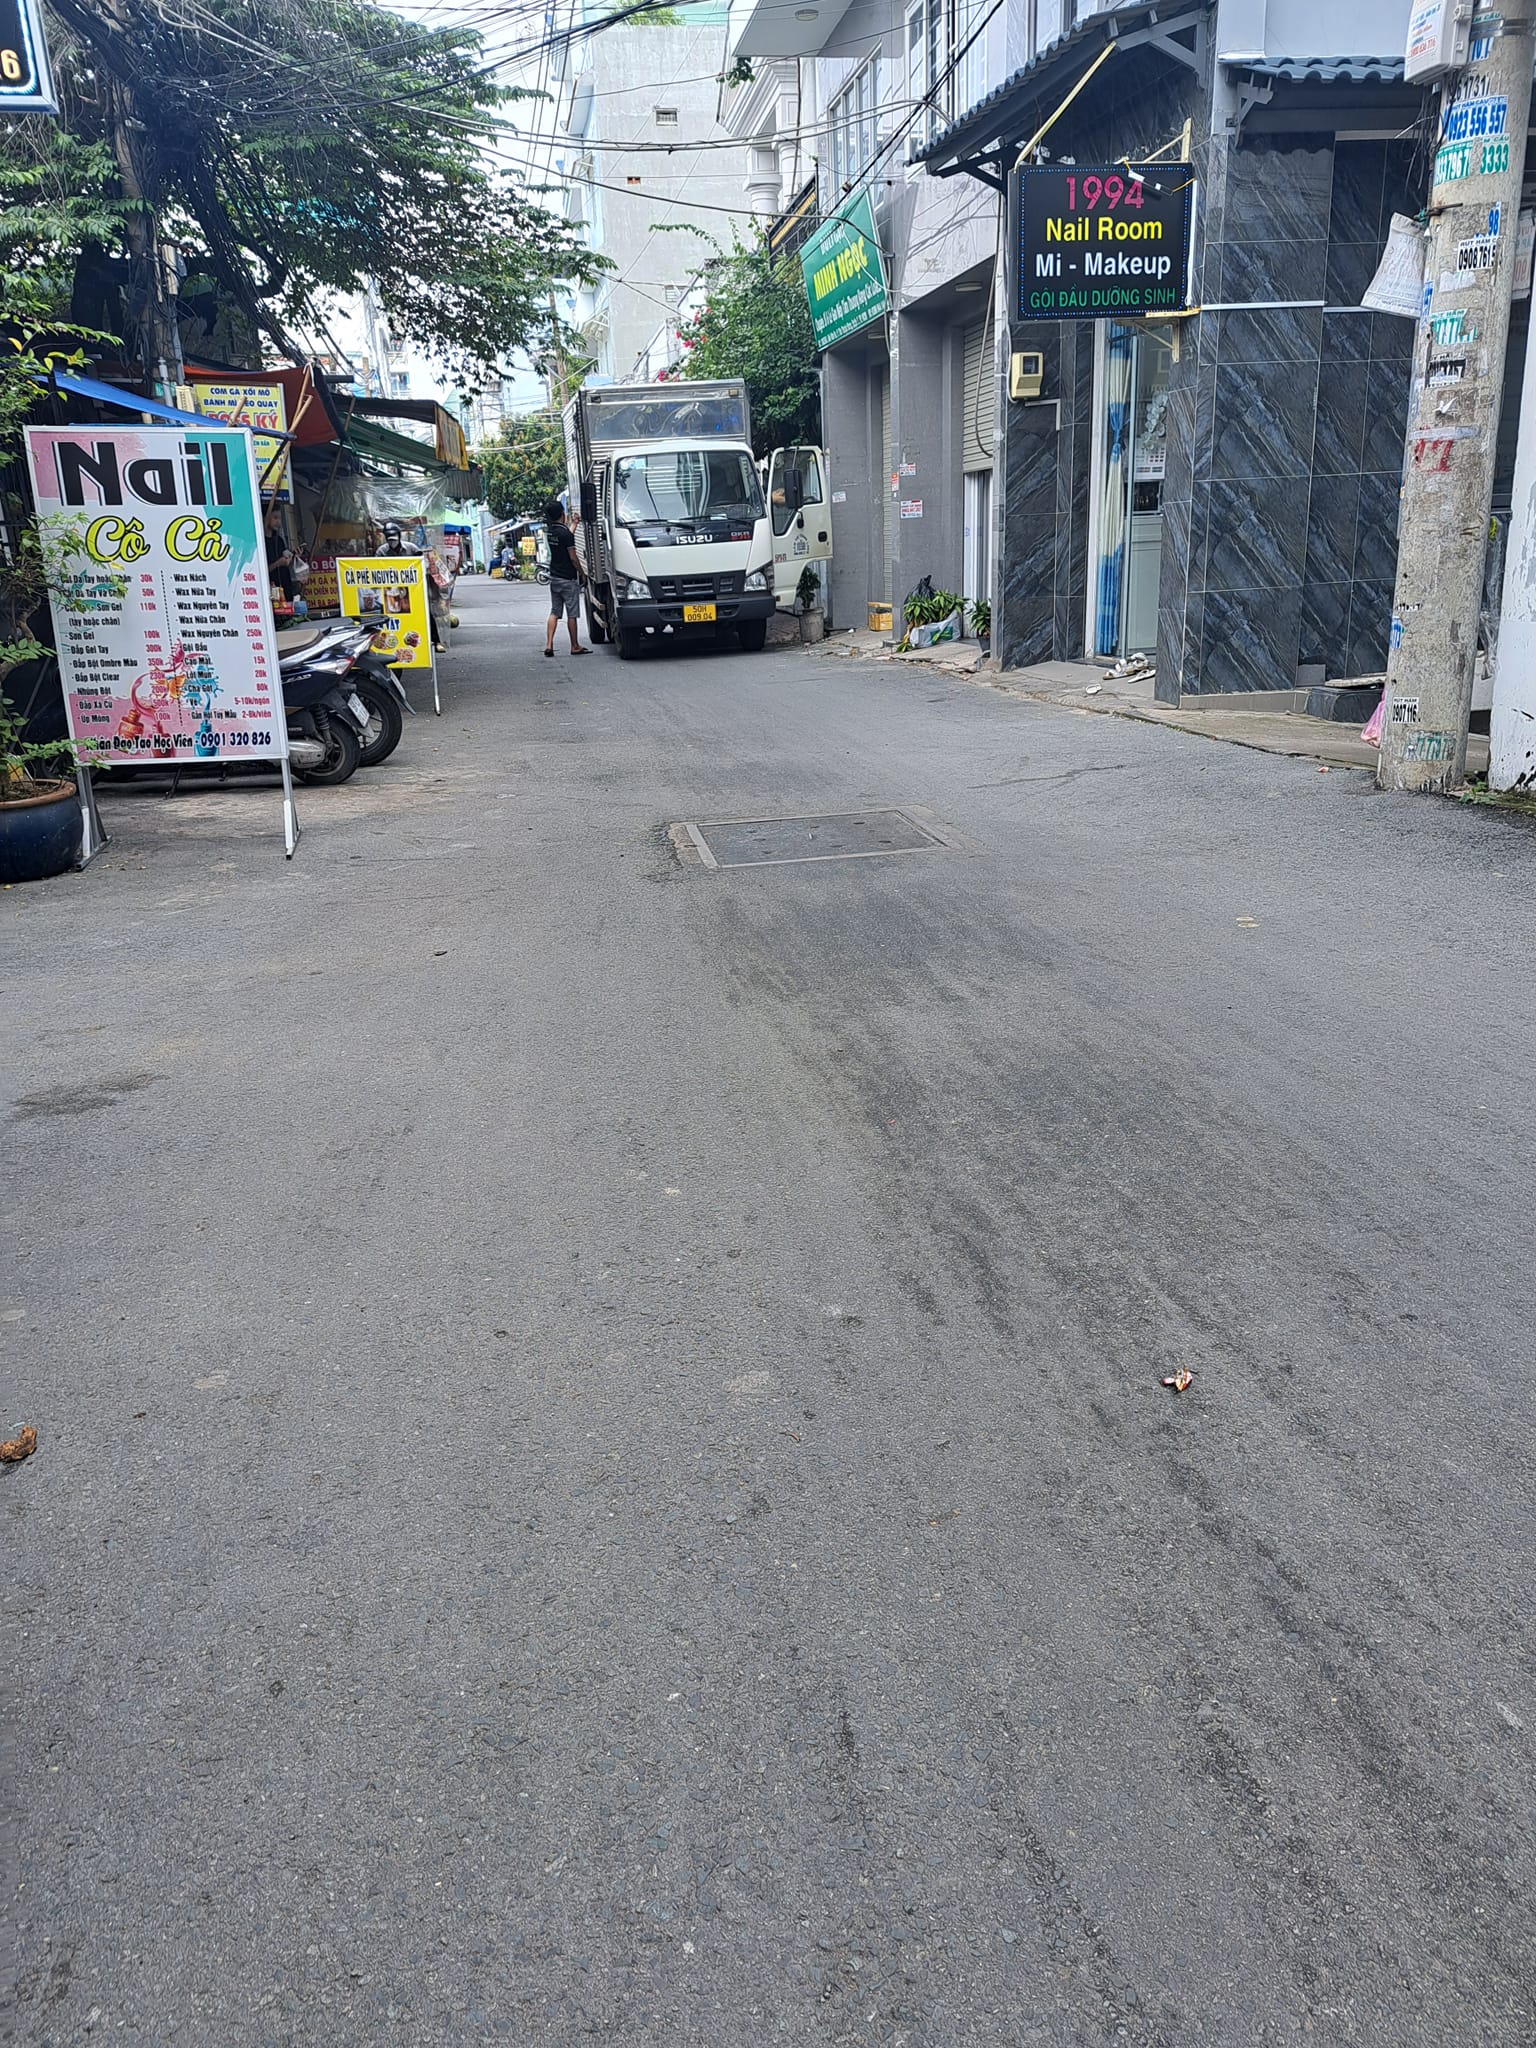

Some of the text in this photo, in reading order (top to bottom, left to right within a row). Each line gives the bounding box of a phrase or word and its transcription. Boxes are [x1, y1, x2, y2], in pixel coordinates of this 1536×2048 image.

[1066, 175, 1145, 210] 1994
[1046, 216, 1163, 241] Nail Room
[813, 236, 868, 301] MINH NGỌC
[1036, 253, 1061, 277] Mi
[1085, 251, 1171, 280] Makeup
[1030, 288, 1054, 311] GỘI
[1059, 283, 1087, 307] ĐẦU
[1144, 288, 1176, 304] SINH
[257, 400, 279, 408] QUAY
[52, 441, 234, 506] Nail
[85, 514, 232, 563] Cô Cả
[676, 534, 713, 544] ISUZU
[140, 574, 152, 582] 30k
[174, 574, 206, 582] Wax Nách
[244, 573, 256, 581] 50k
[356, 566, 371, 585] PHÊ
[371, 566, 399, 584] NGUYÊN
[400, 564, 419, 584] CHẤT
[142, 589, 154, 597] 50k
[175, 588, 189, 596] Wax
[206, 588, 216, 596] Tay
[242, 587, 257, 595] 100k
[112, 603, 122, 611] Gel
[177, 602, 229, 611] Wax Nguyên Tay
[243, 601, 259, 609] 200k
[179, 616, 193, 624] Wax
[245, 615, 260, 623] 100k
[84, 632, 94, 640] Gel
[181, 629, 239, 638] Wax Nguyên Chân
[246, 629, 262, 637] 250k
[98, 646, 108, 654] Tay
[254, 656, 265, 664] 15k
[102, 673, 120, 681] Clear
[255, 670, 267, 678] 20k
[173, 733, 193, 748] Viên
[201, 733, 226, 747] 0901
[230, 732, 249, 746] 320
[252, 732, 271, 746] 826
